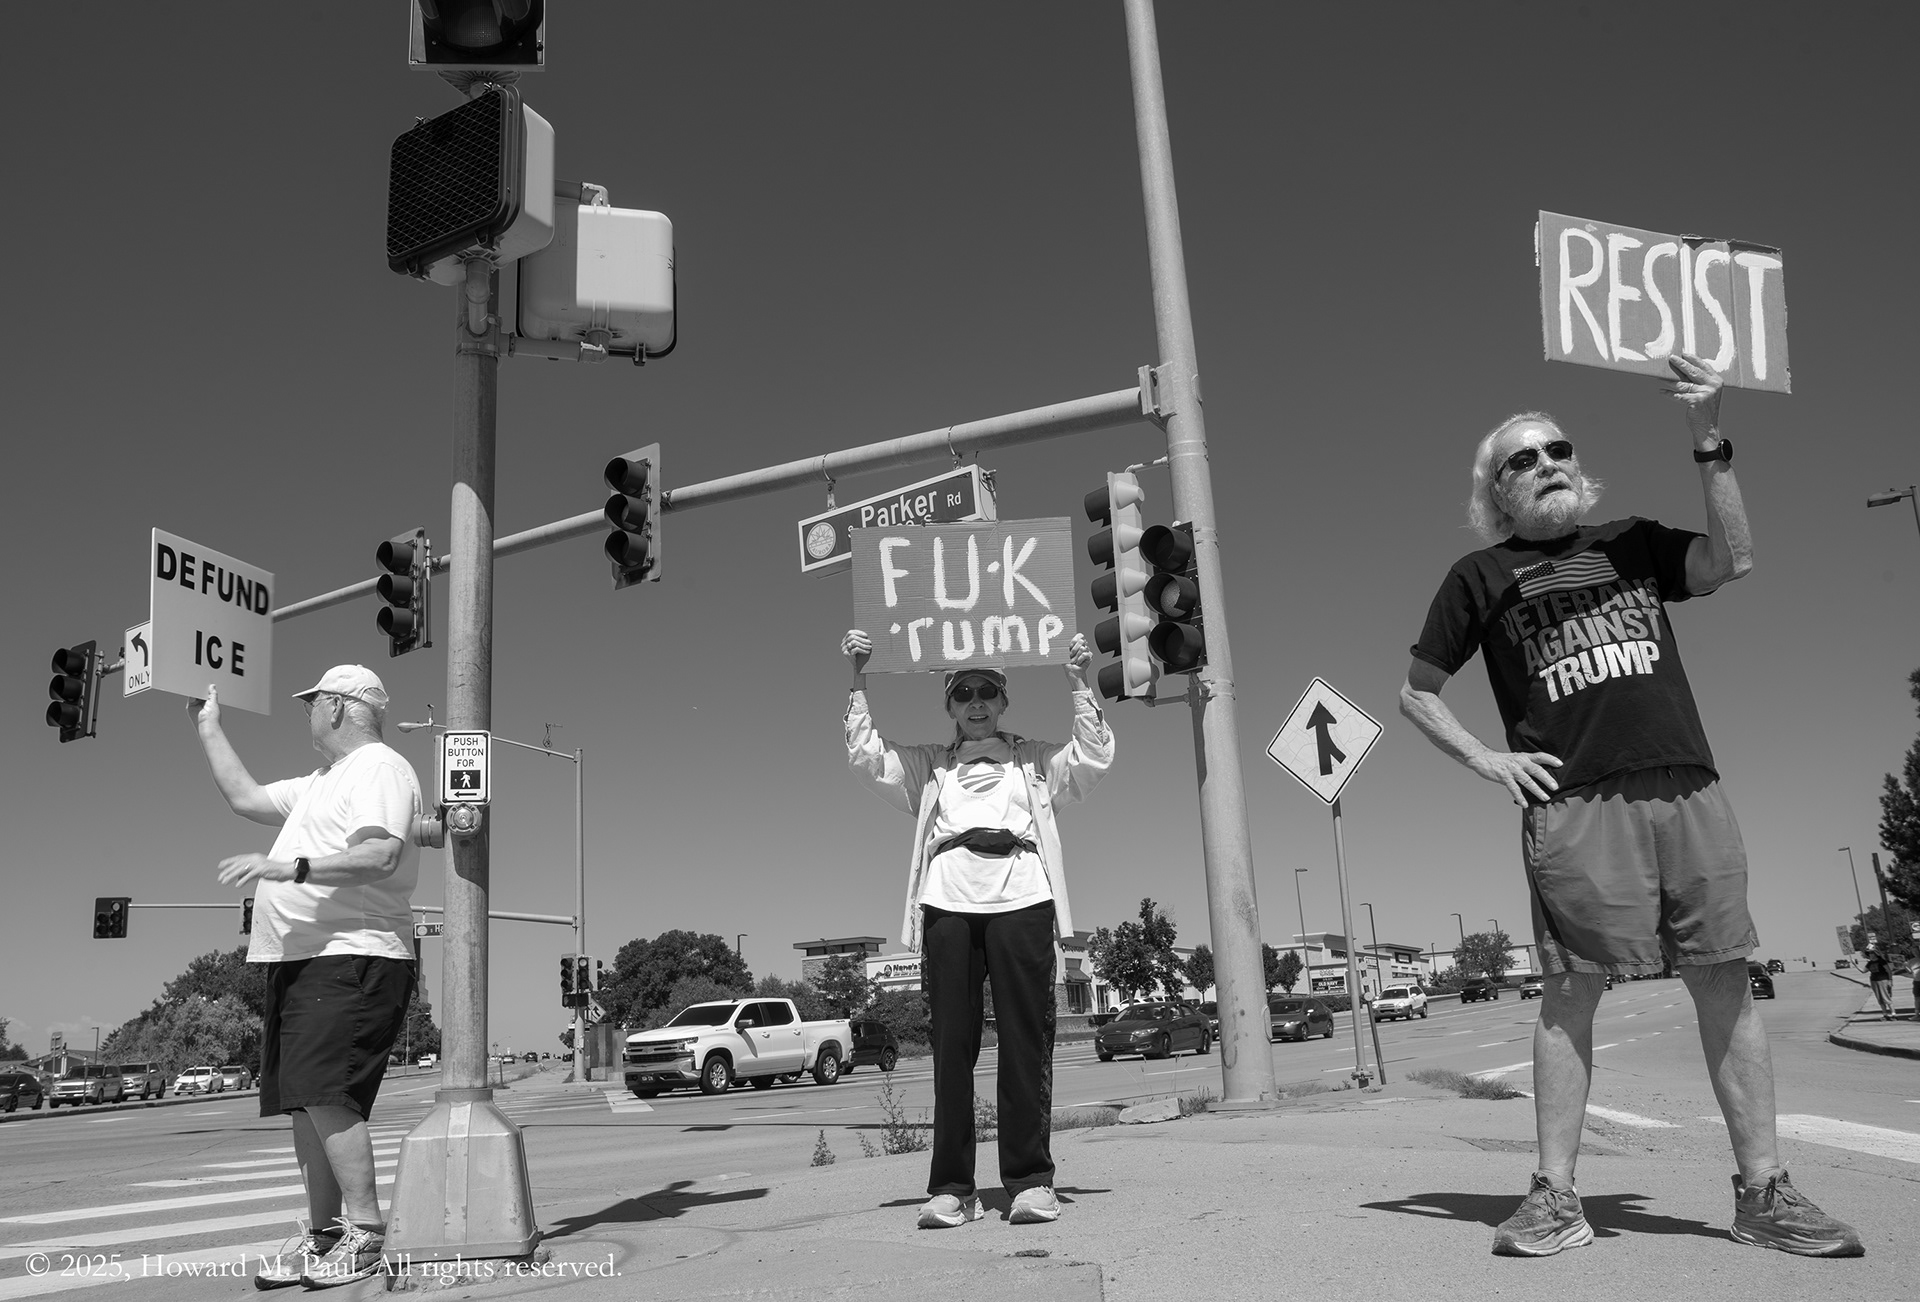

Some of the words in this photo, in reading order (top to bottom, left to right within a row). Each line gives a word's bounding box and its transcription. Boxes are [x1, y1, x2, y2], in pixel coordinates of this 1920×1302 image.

[1559, 228, 1783, 381] RESIST
[861, 490, 937, 528] Parker
[946, 491, 962, 507] Rd
[157, 542, 270, 616] DEFUND
[1500, 576, 1661, 647] VETERANS
[195, 630, 245, 677] ICE
[1522, 607, 1662, 676] AGAINST
[128, 671, 151, 689] ONLY
[1538, 640, 1661, 703] TRUMP
[447, 748, 484, 757] BUTTON
[453, 737, 479, 746] PUSH
[456, 758, 475, 767] FOR
